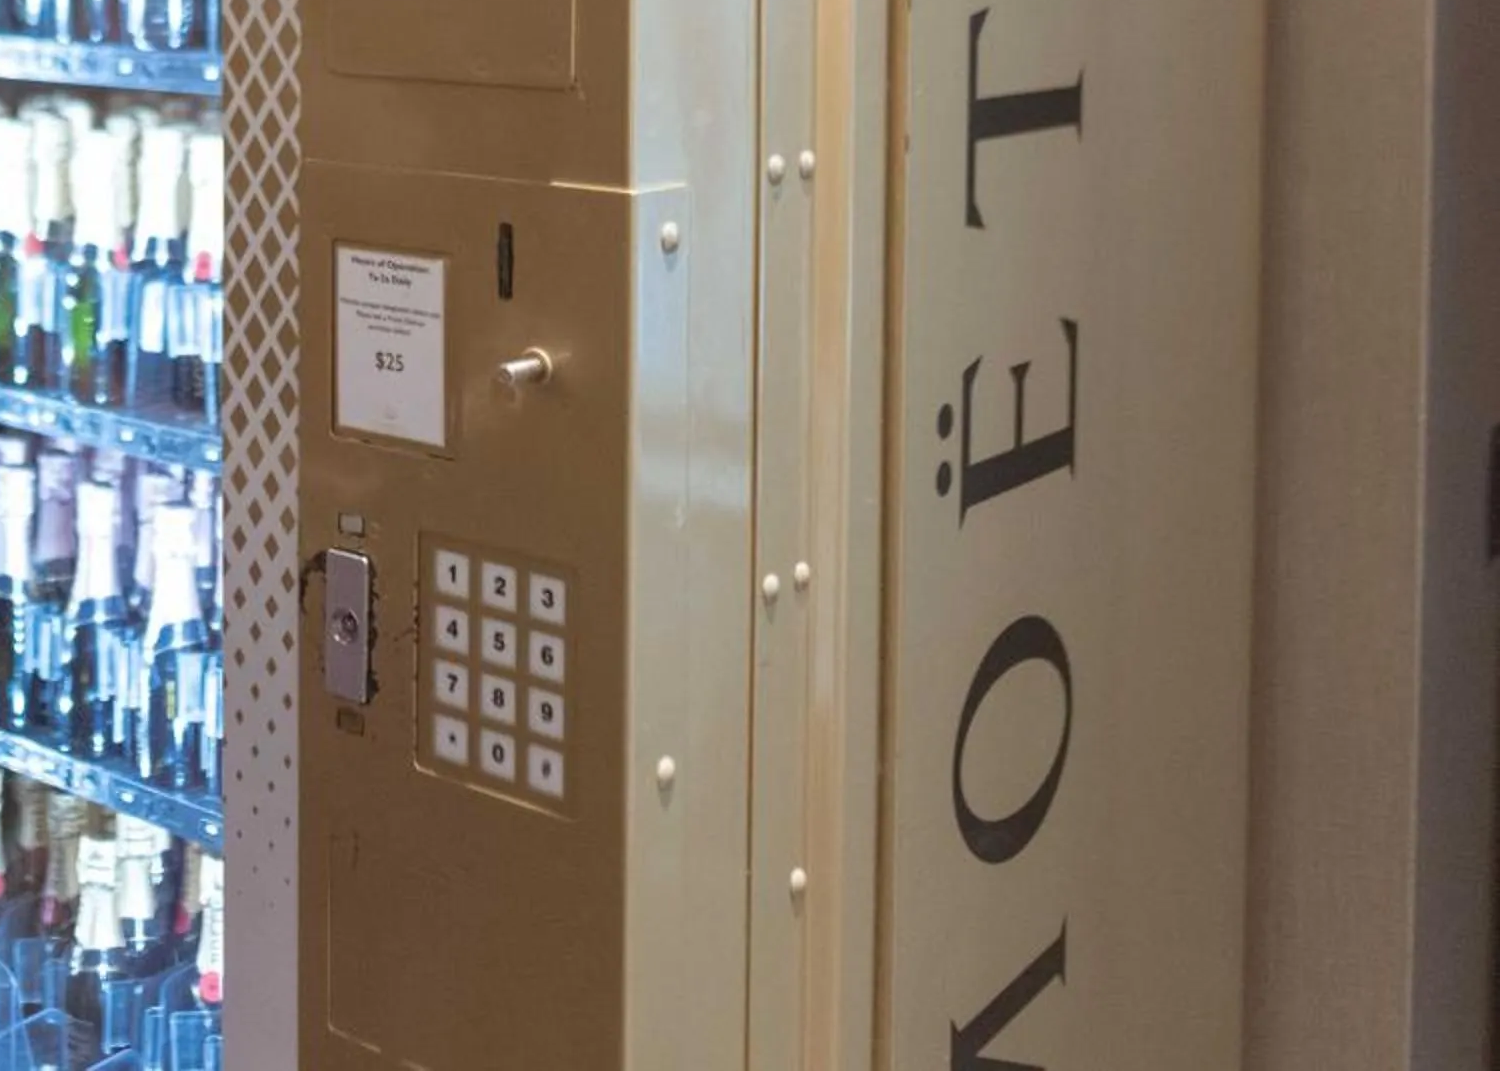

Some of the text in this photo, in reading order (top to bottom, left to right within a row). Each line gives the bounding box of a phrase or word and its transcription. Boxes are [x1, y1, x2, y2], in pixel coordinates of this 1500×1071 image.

[375, 351, 405, 373] $25
[448, 564, 554, 609] 1 2 3
[446, 619, 554, 666] 4 5 6
[447, 674, 554, 723] 7 8 9
[492, 744, 504, 764] 0
